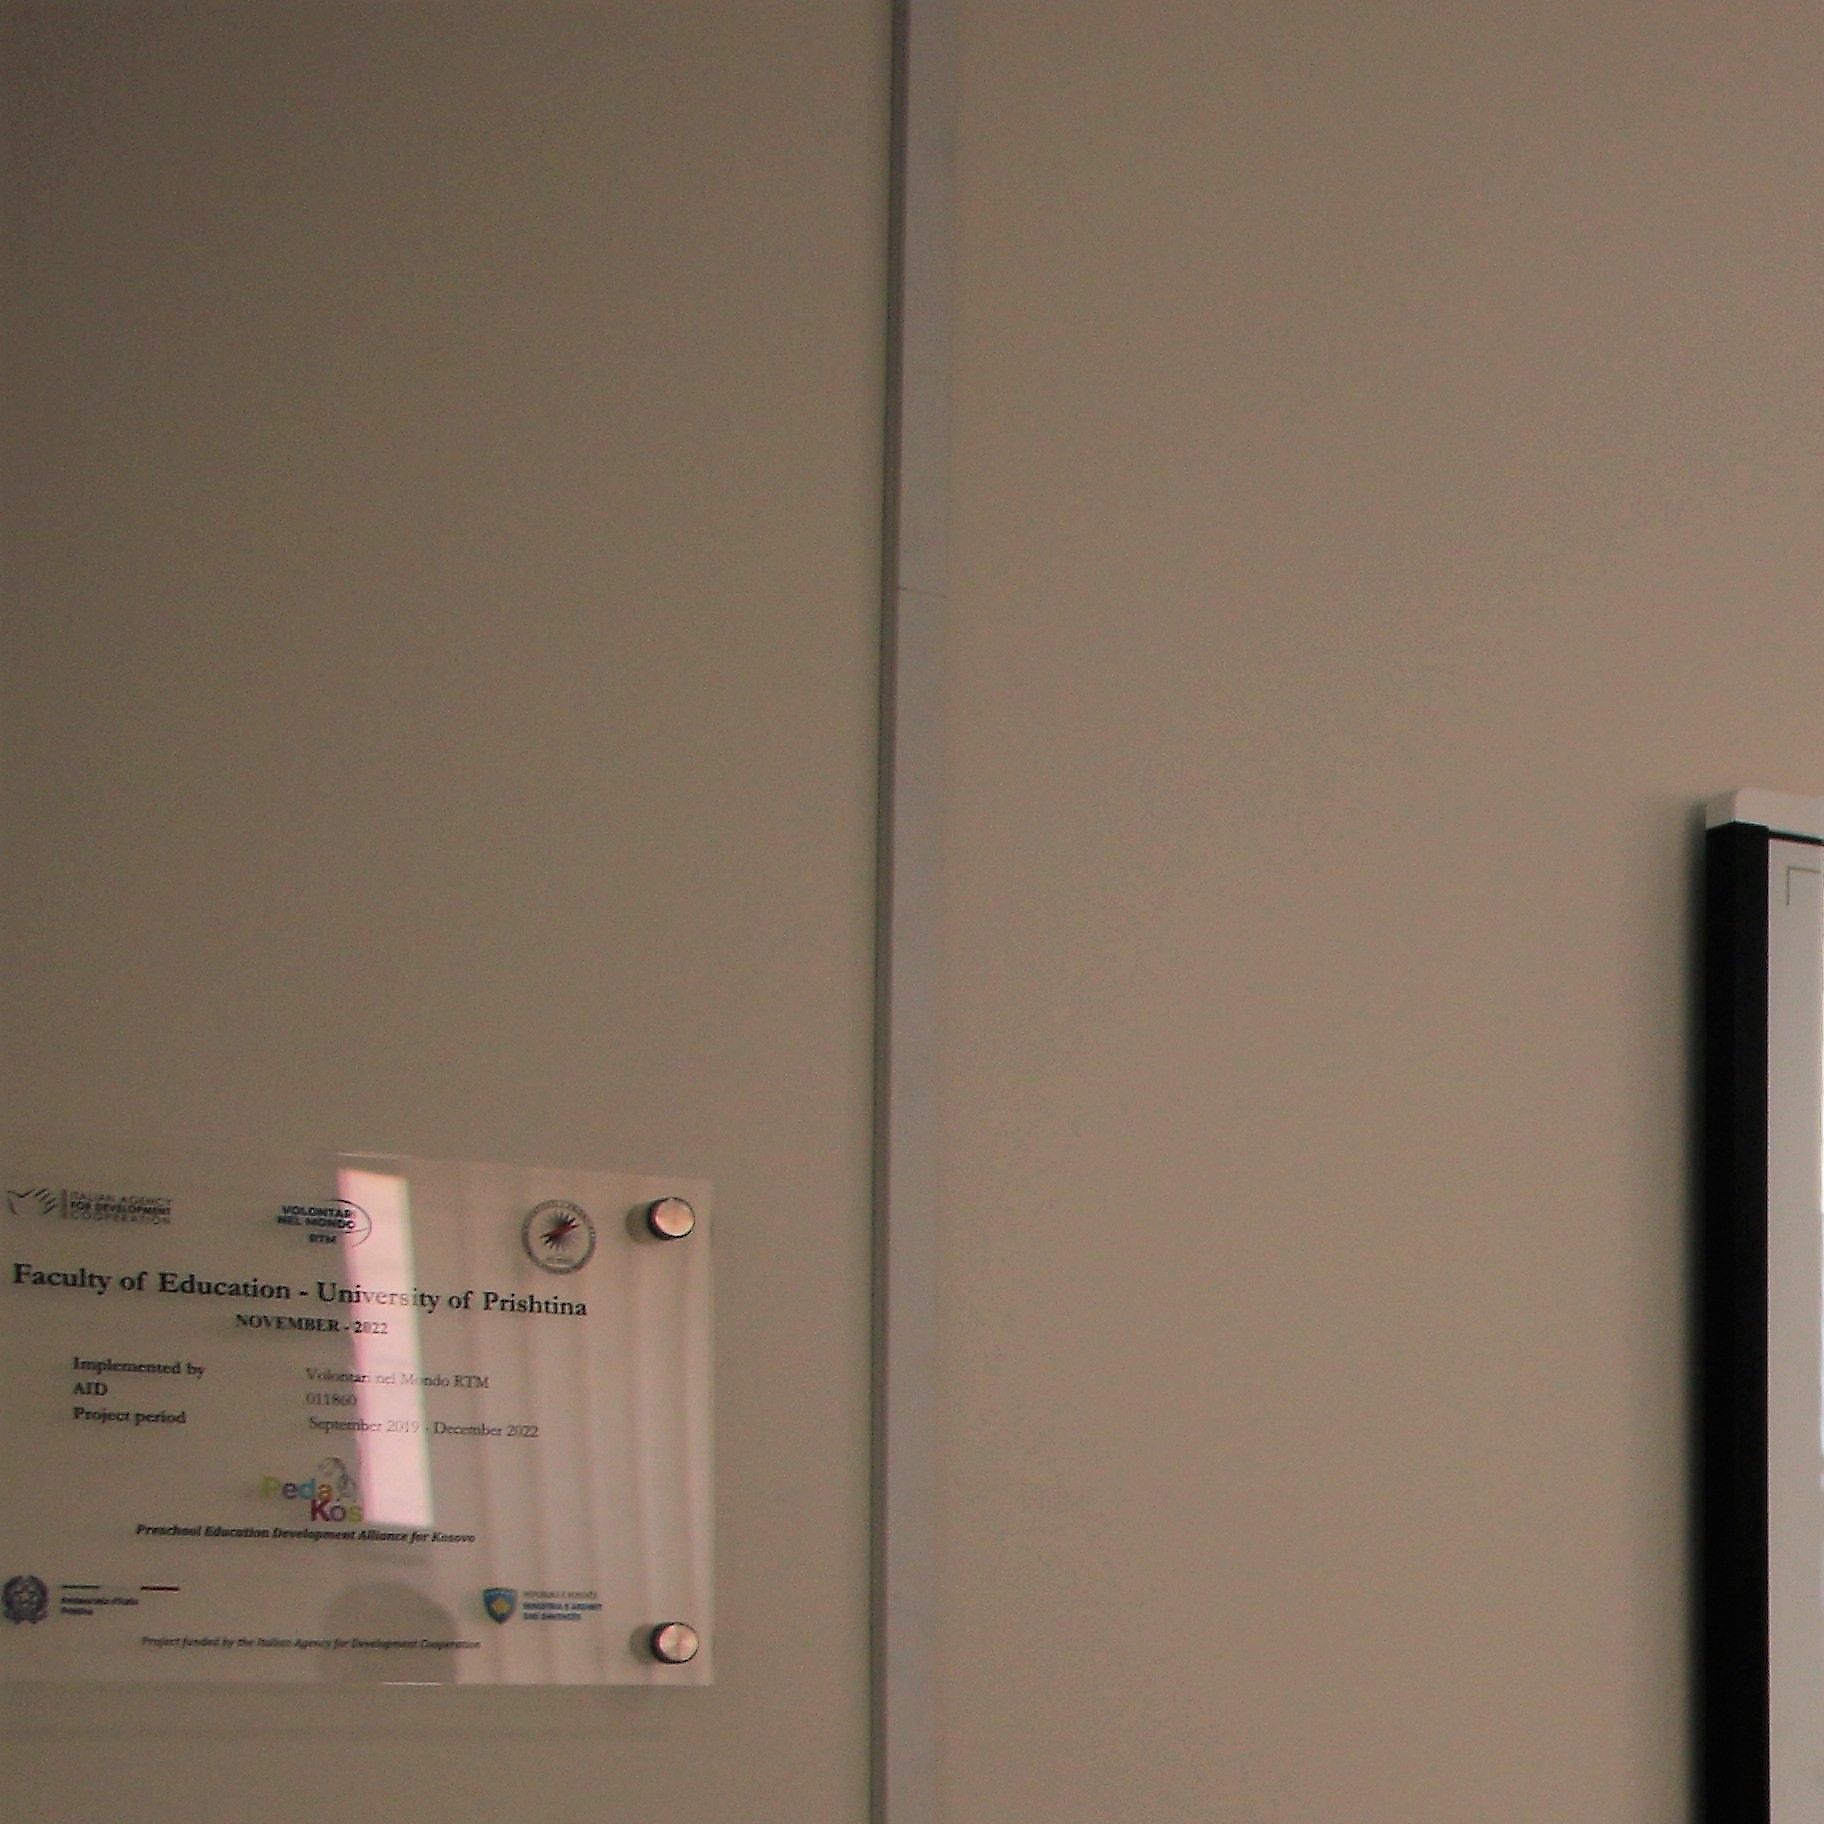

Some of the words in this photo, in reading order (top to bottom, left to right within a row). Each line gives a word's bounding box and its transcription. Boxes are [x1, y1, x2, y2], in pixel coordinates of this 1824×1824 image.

[13, 1262, 112, 1294] Faculty
[119, 1271, 149, 1292] of
[159, 1271, 292, 1300] Education
[316, 1281, 442, 1314] University
[448, 1290, 474, 1310] of
[483, 1291, 588, 1317] Prishtina
[235, 1313, 341, 1333] NOVEMBER
[353, 1320, 389, 1335] 2022
[72, 1357, 182, 1377] Implemented
[186, 1361, 207, 1379] by
[73, 1382, 109, 1397] AID
[453, 1375, 490, 1389] RTM
[73, 1406, 131, 1423] Project
[134, 1410, 187, 1426] period
[309, 1416, 382, 1434] September
[433, 1421, 502, 1437] December
[506, 1425, 539, 1439] 2022
[260, 1475, 334, 1499] Peda
[310, 1499, 363, 1524] Kos
[136, 1524, 202, 1538] Preschool
[204, 1526, 270, 1539] Education
[272, 1527, 355, 1542] Development
[357, 1530, 409, 1542] Alliance
[410, 1530, 428, 1543] for
[431, 1531, 476, 1543] Kosovo
